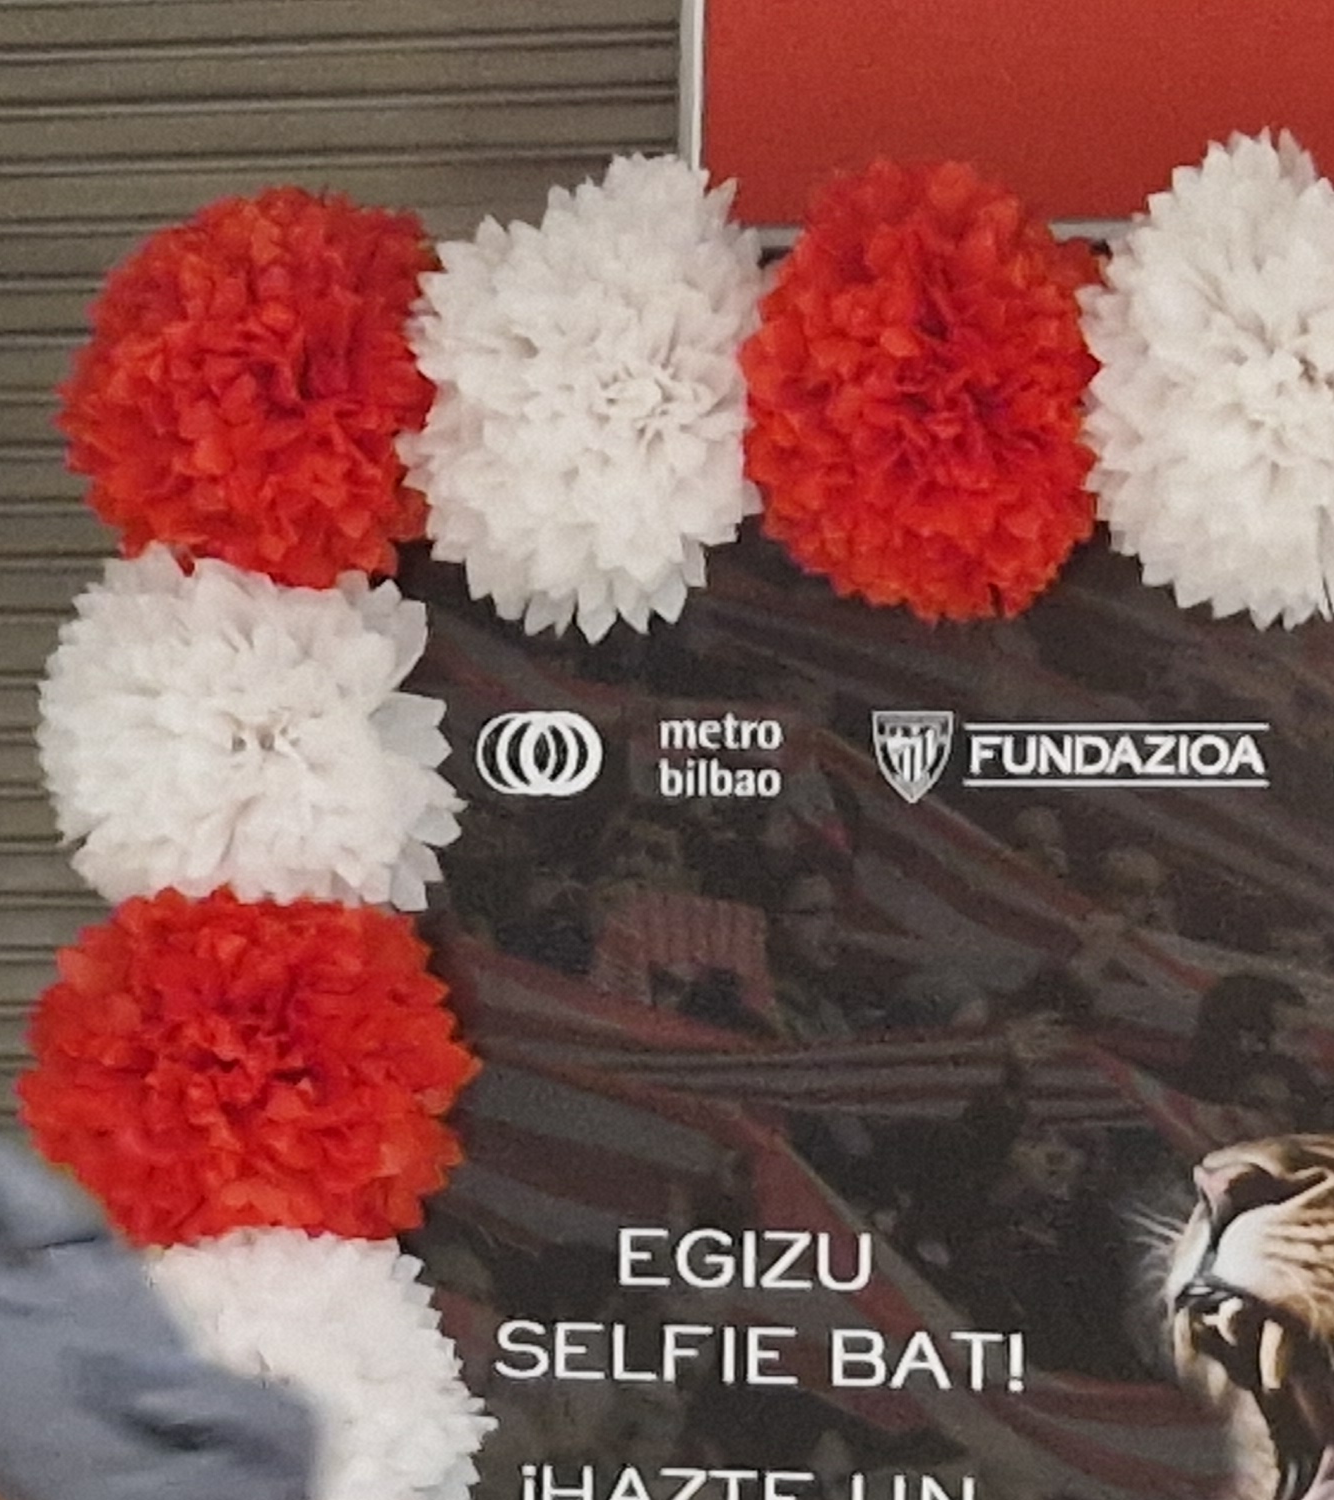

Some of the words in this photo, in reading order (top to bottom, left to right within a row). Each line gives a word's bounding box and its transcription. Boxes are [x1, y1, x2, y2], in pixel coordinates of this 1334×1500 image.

[659, 712, 785, 750] metro
[970, 734, 1266, 776] FUNDAZIOA
[658, 758, 783, 798] bilbao
[619, 1228, 873, 1291] EGIZU
[495, 1320, 799, 1385] SELFIE
[832, 1328, 1025, 1393] BAT!
